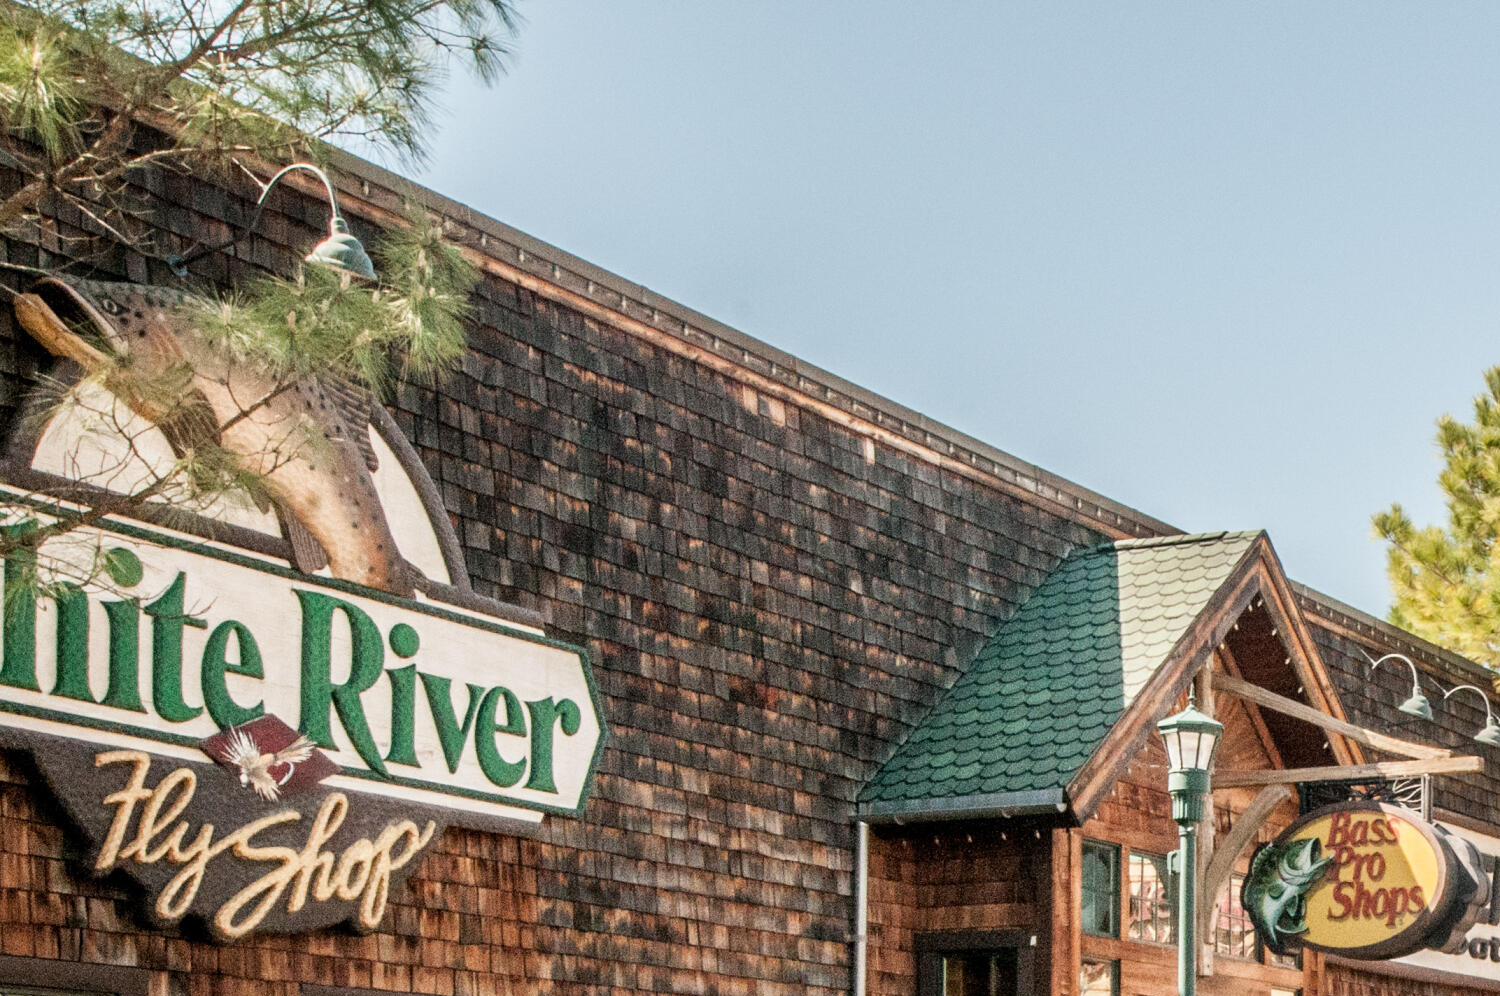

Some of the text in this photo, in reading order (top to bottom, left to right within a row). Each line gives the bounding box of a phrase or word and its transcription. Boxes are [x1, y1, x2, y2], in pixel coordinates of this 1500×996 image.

[0, 513, 582, 797] hite River
[95, 750, 436, 940] Fly Shop
[1324, 811, 1400, 848] Bass
[1327, 846, 1386, 882] Pro
[1326, 880, 1425, 928] Shops
